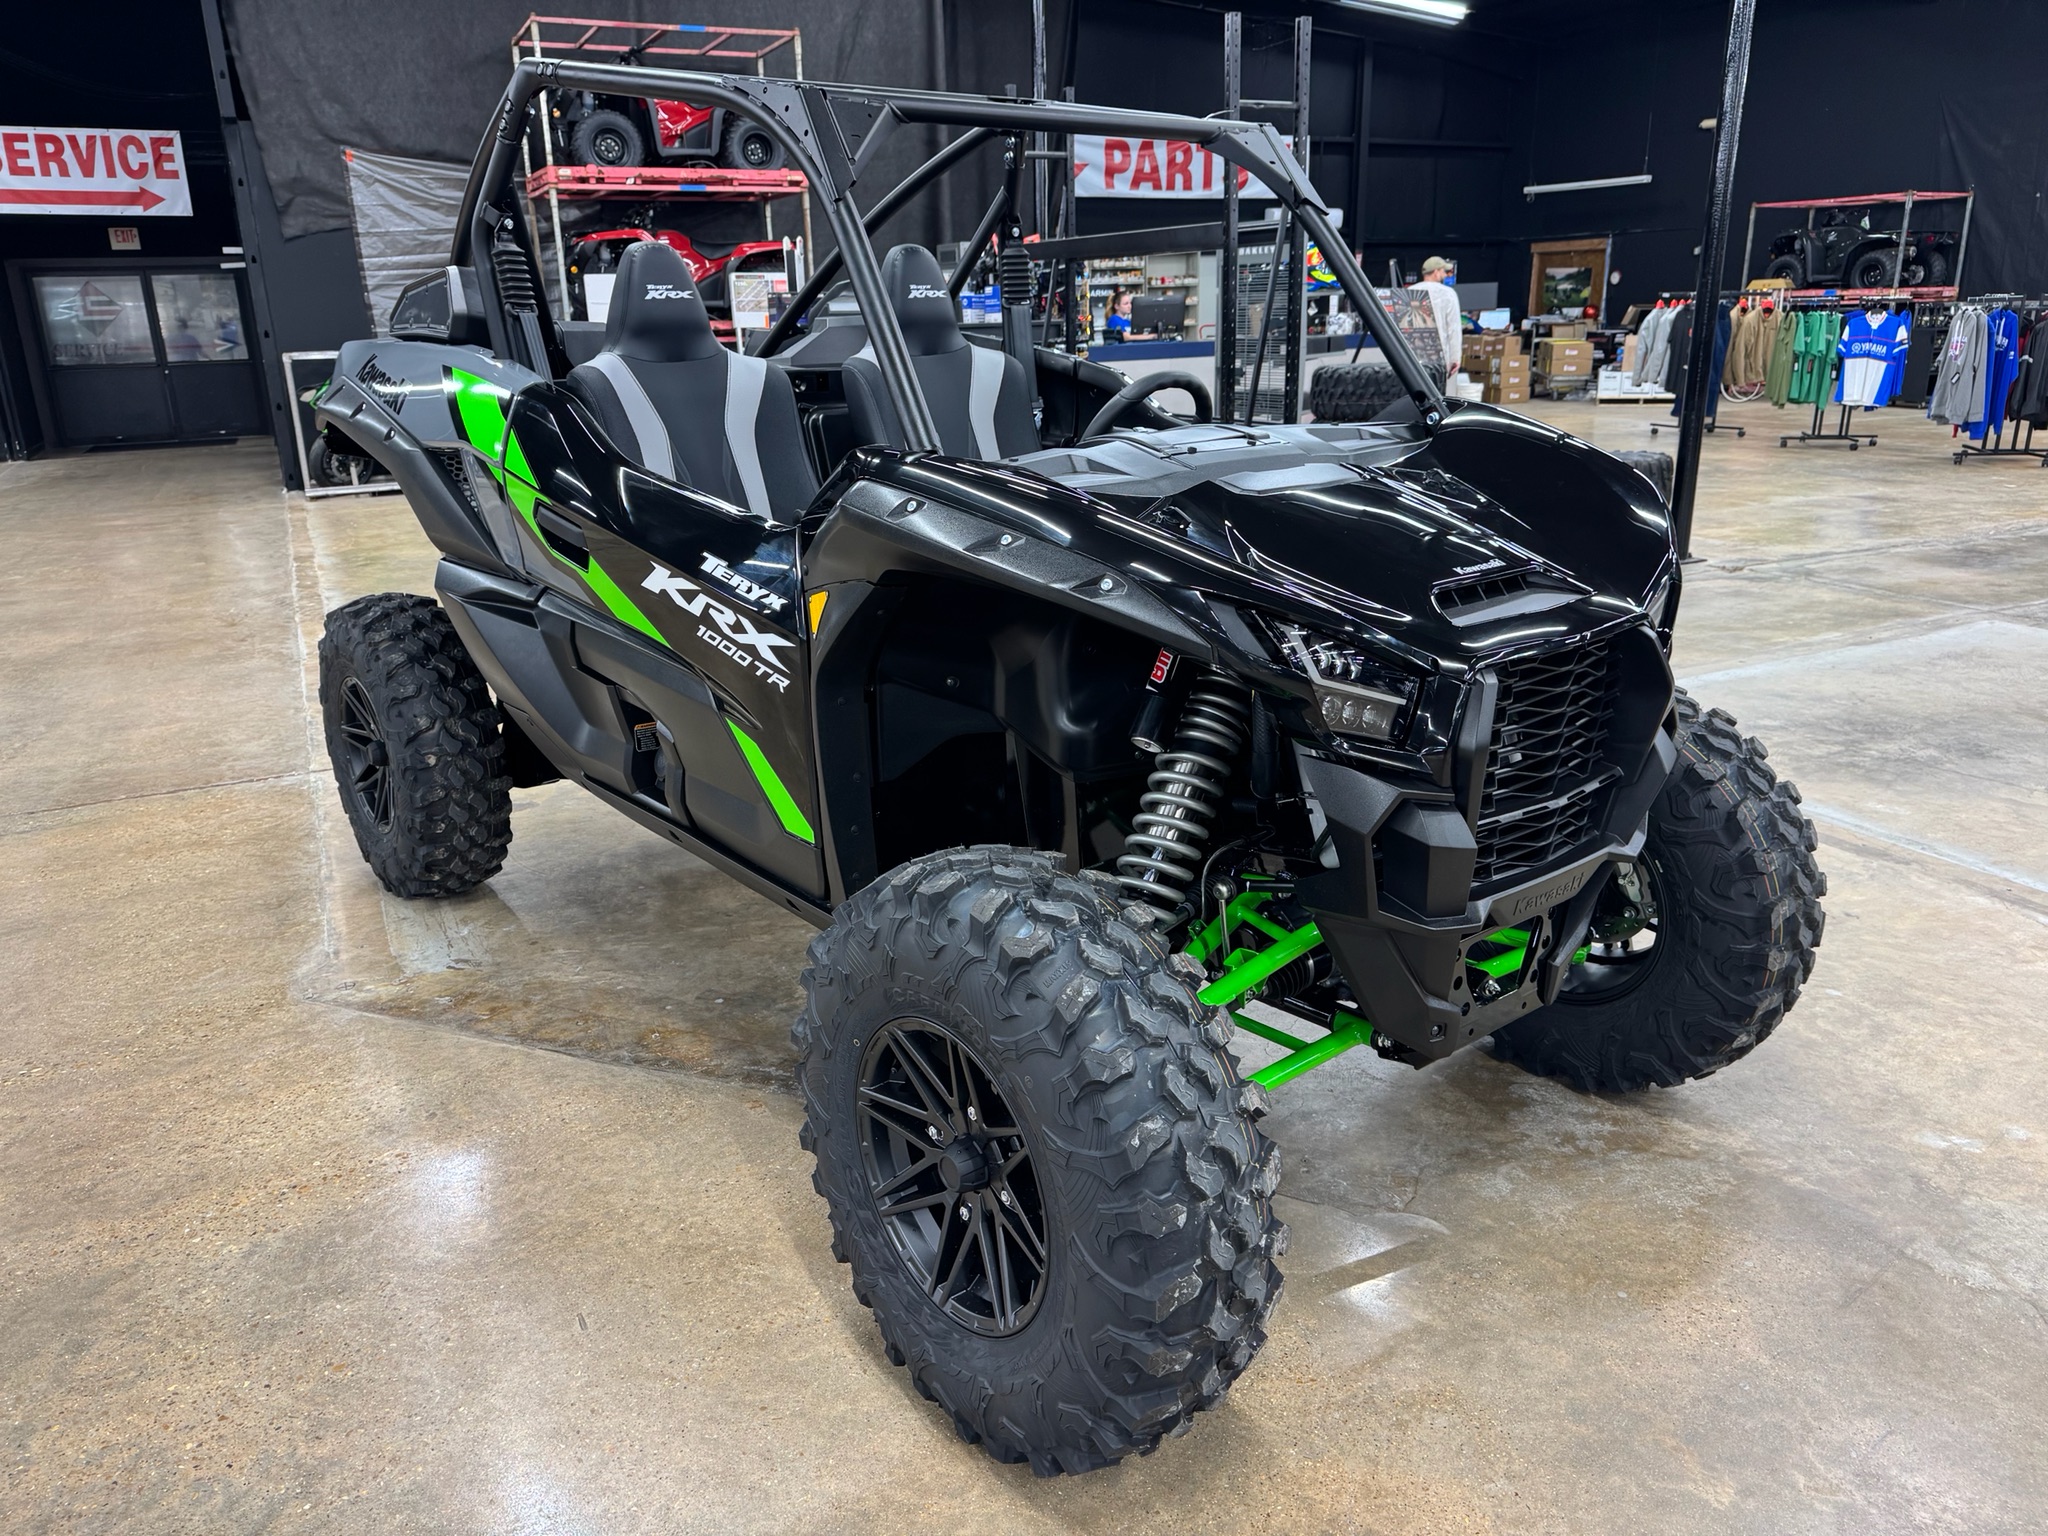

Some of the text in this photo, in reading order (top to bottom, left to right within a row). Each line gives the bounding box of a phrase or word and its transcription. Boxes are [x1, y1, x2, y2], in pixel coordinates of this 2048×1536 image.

[0, 132, 180, 180] ERVICE
[114, 229, 136, 243] EXIT
[1238, 244, 1276, 256] OAKLEY
[644, 289, 695, 300] KRX
[907, 289, 948, 299] KRX
[52, 343, 123, 358] SERVICE
[1861, 342, 1887, 355] YAMAHA
[1452, 558, 1507, 575] Kawasaki
[641, 560, 797, 674] KRX
[1512, 871, 1585, 916] Kawasaki
